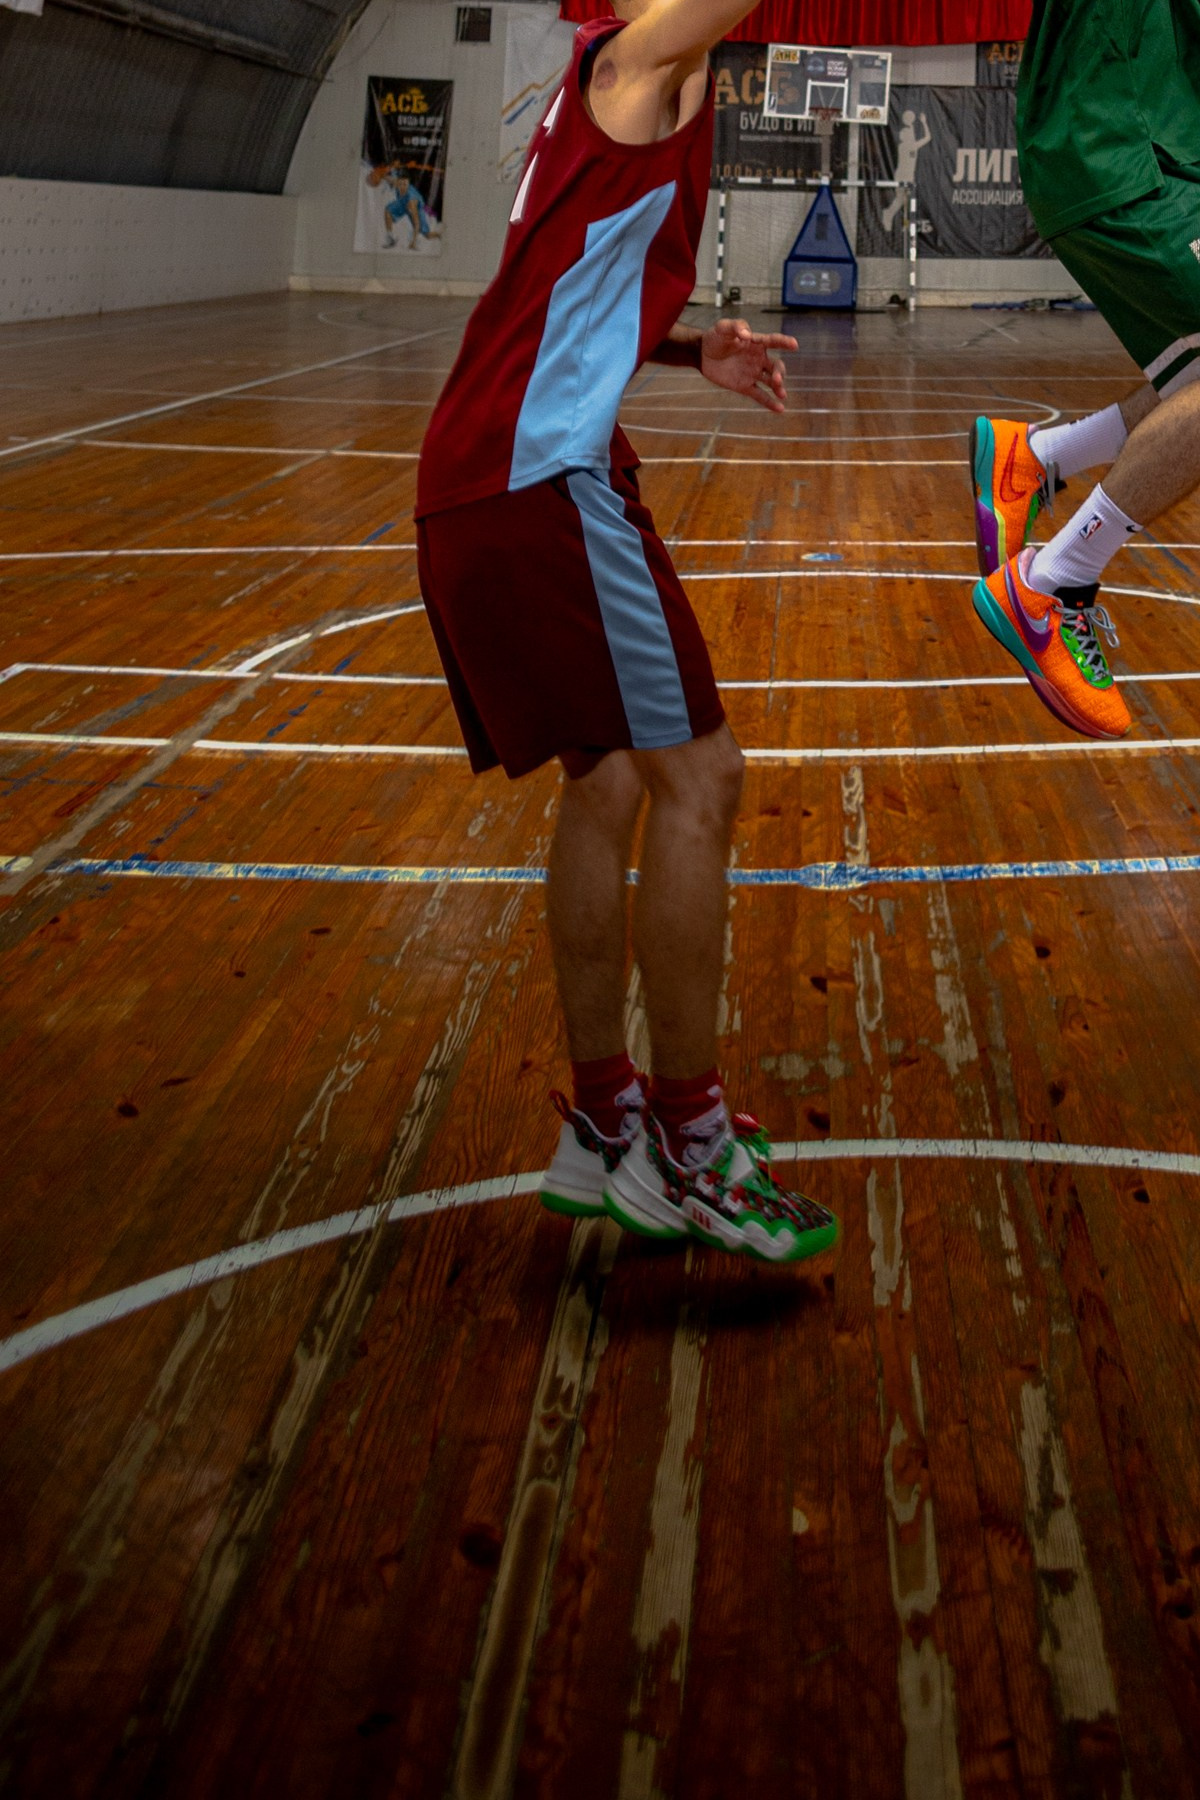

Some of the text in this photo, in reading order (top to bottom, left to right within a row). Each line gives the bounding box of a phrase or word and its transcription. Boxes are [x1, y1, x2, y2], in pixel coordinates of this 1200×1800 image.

[381, 92, 429, 115] АСБ
[952, 148, 1022, 183] ЛИГ
[952, 189, 1024, 206] АССОЦИАЦИЯ
